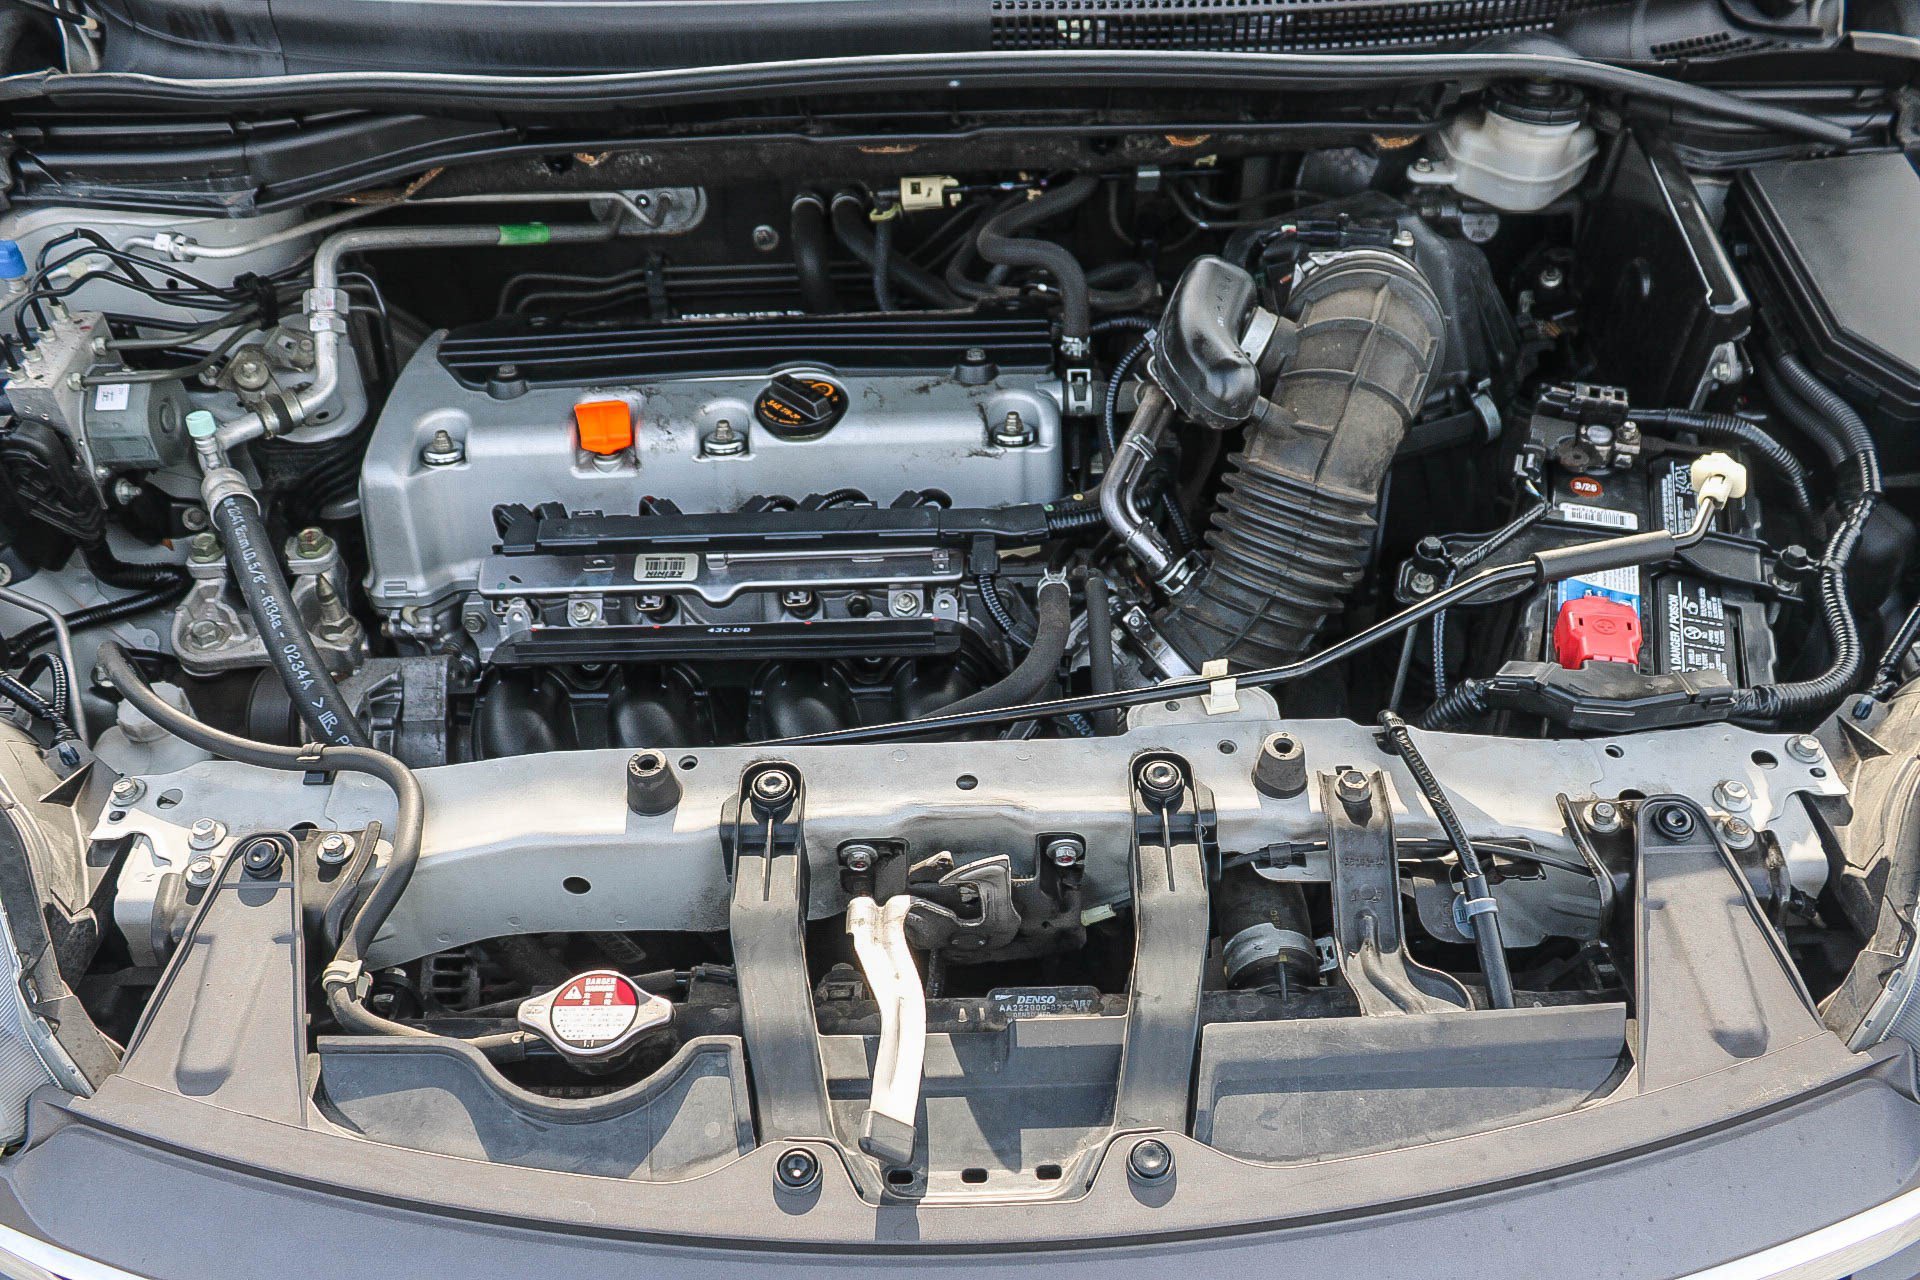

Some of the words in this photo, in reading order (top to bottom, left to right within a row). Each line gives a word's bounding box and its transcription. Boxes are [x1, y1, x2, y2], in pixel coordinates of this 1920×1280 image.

[1668, 593, 1680, 624] POISON
[261, 595, 283, 630] R134a
[283, 644, 315, 691] 0234A
[1669, 631, 1682, 665] DANGER
[1016, 995, 1057, 1005] DENSO
[583, 1040, 595, 1048] 1.1
